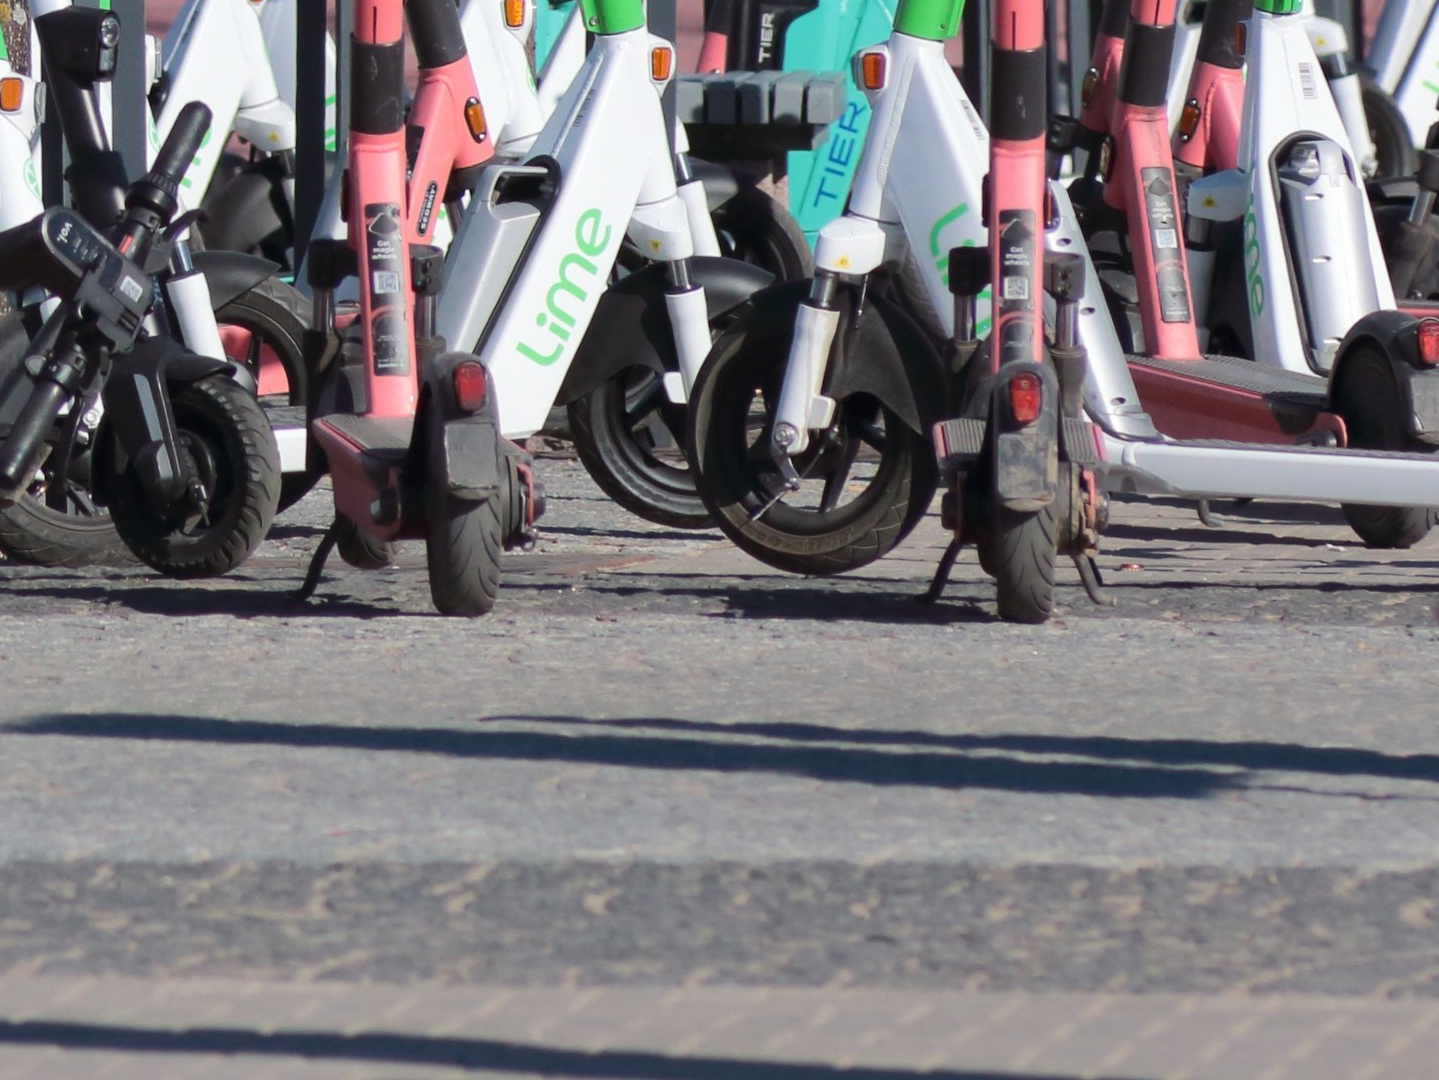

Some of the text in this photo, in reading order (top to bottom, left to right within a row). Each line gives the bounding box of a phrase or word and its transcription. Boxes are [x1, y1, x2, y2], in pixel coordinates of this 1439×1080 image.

[759, 13, 775, 63] TIER
[814, 101, 867, 207] TIER
[516, 208, 612, 366] Lime
